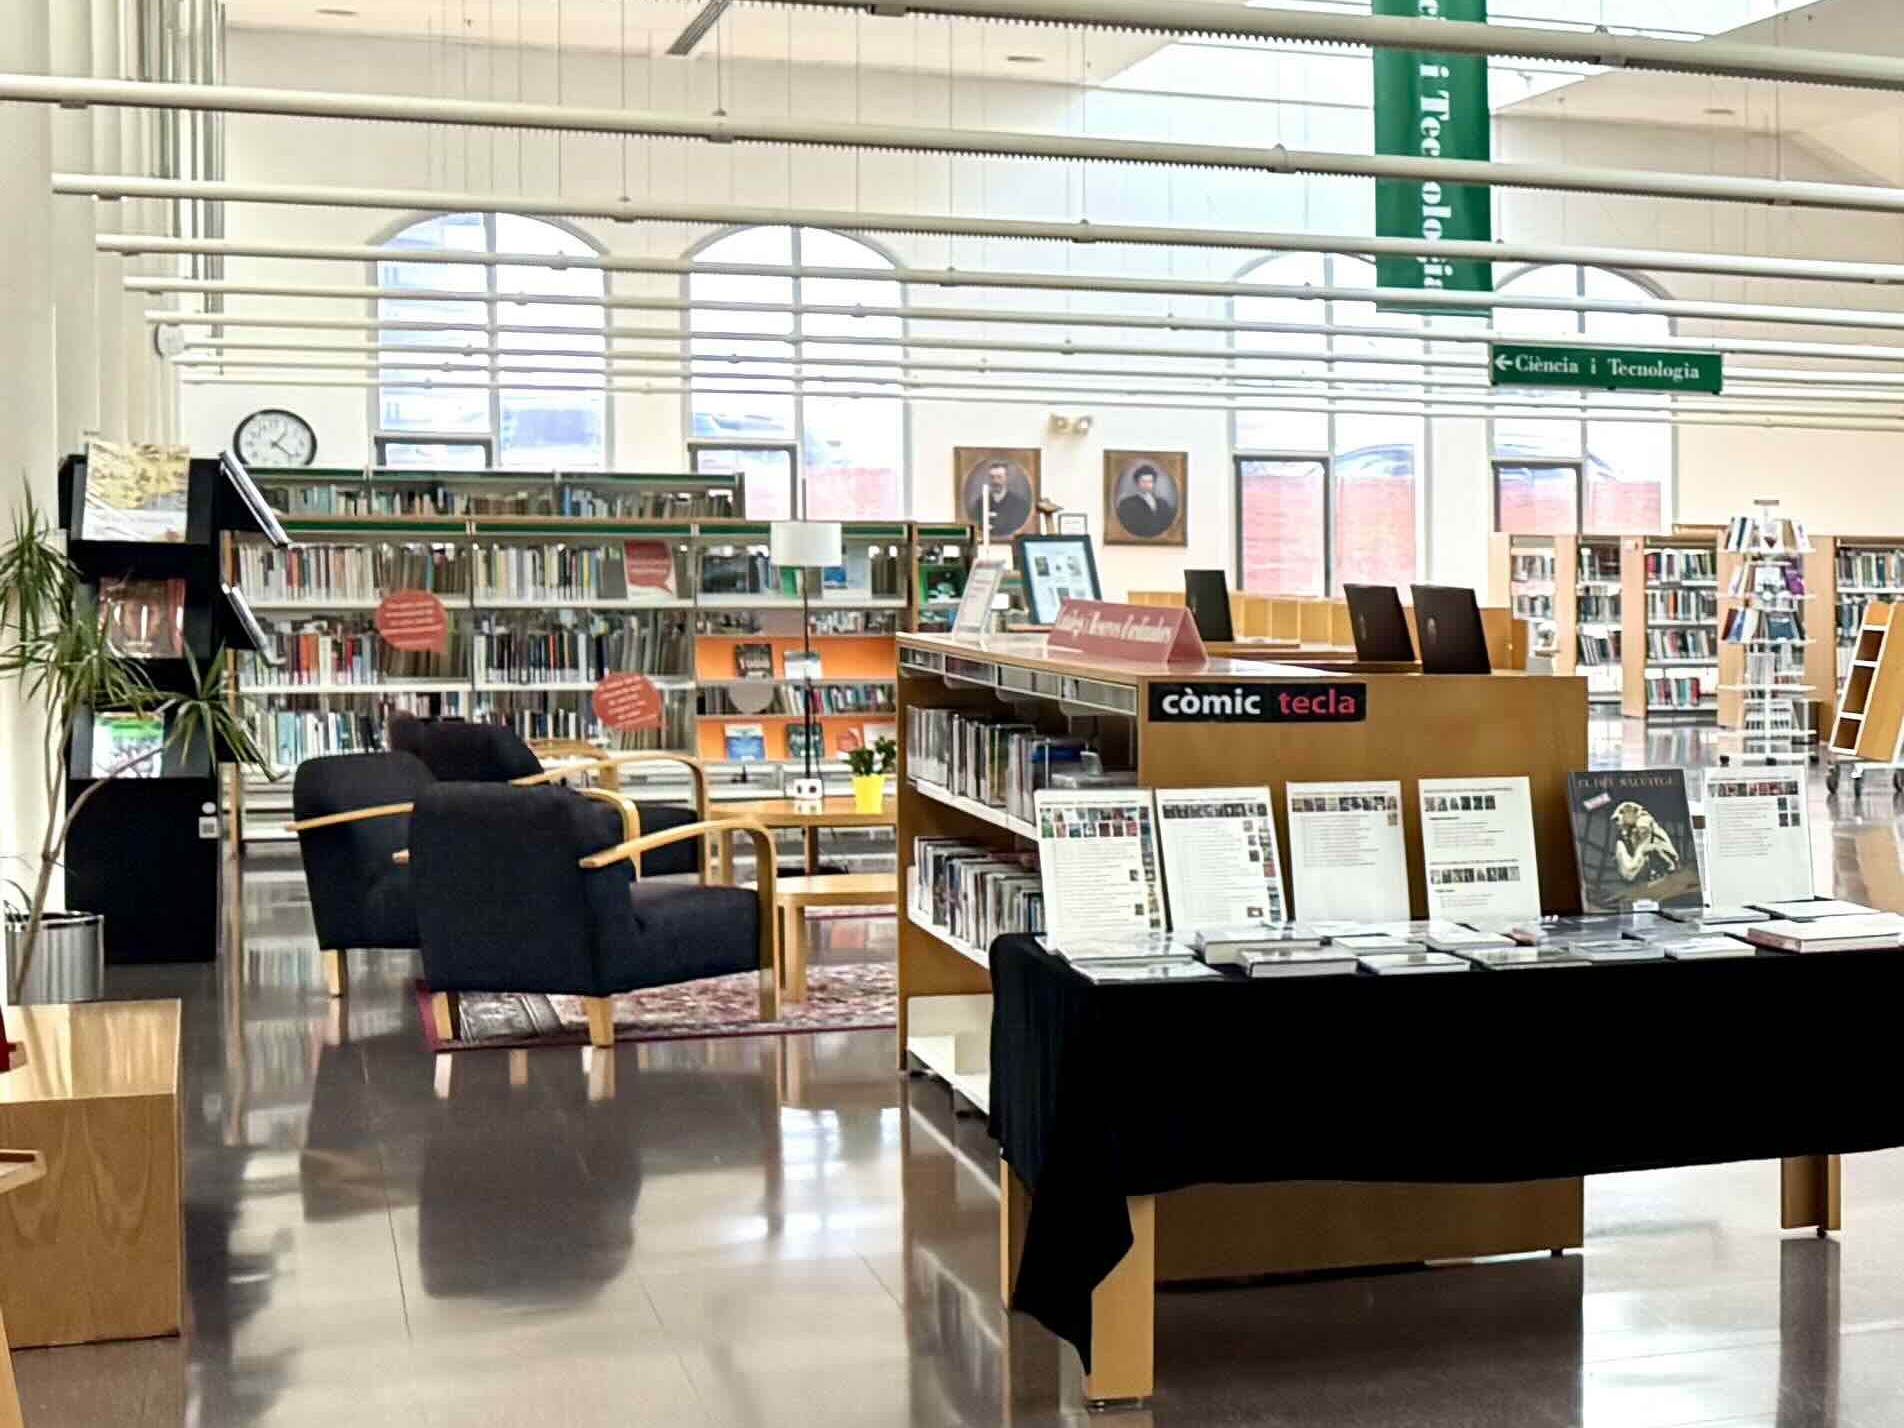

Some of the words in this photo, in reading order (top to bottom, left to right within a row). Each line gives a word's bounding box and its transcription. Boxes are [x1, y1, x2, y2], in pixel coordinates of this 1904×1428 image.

[1514, 353, 1579, 374] Ciència
[1590, 357, 1597, 375] i
[1607, 357, 1700, 383] Tecnologia
[1161, 687, 1261, 715] còmic
[1278, 688, 1356, 715] tecla
